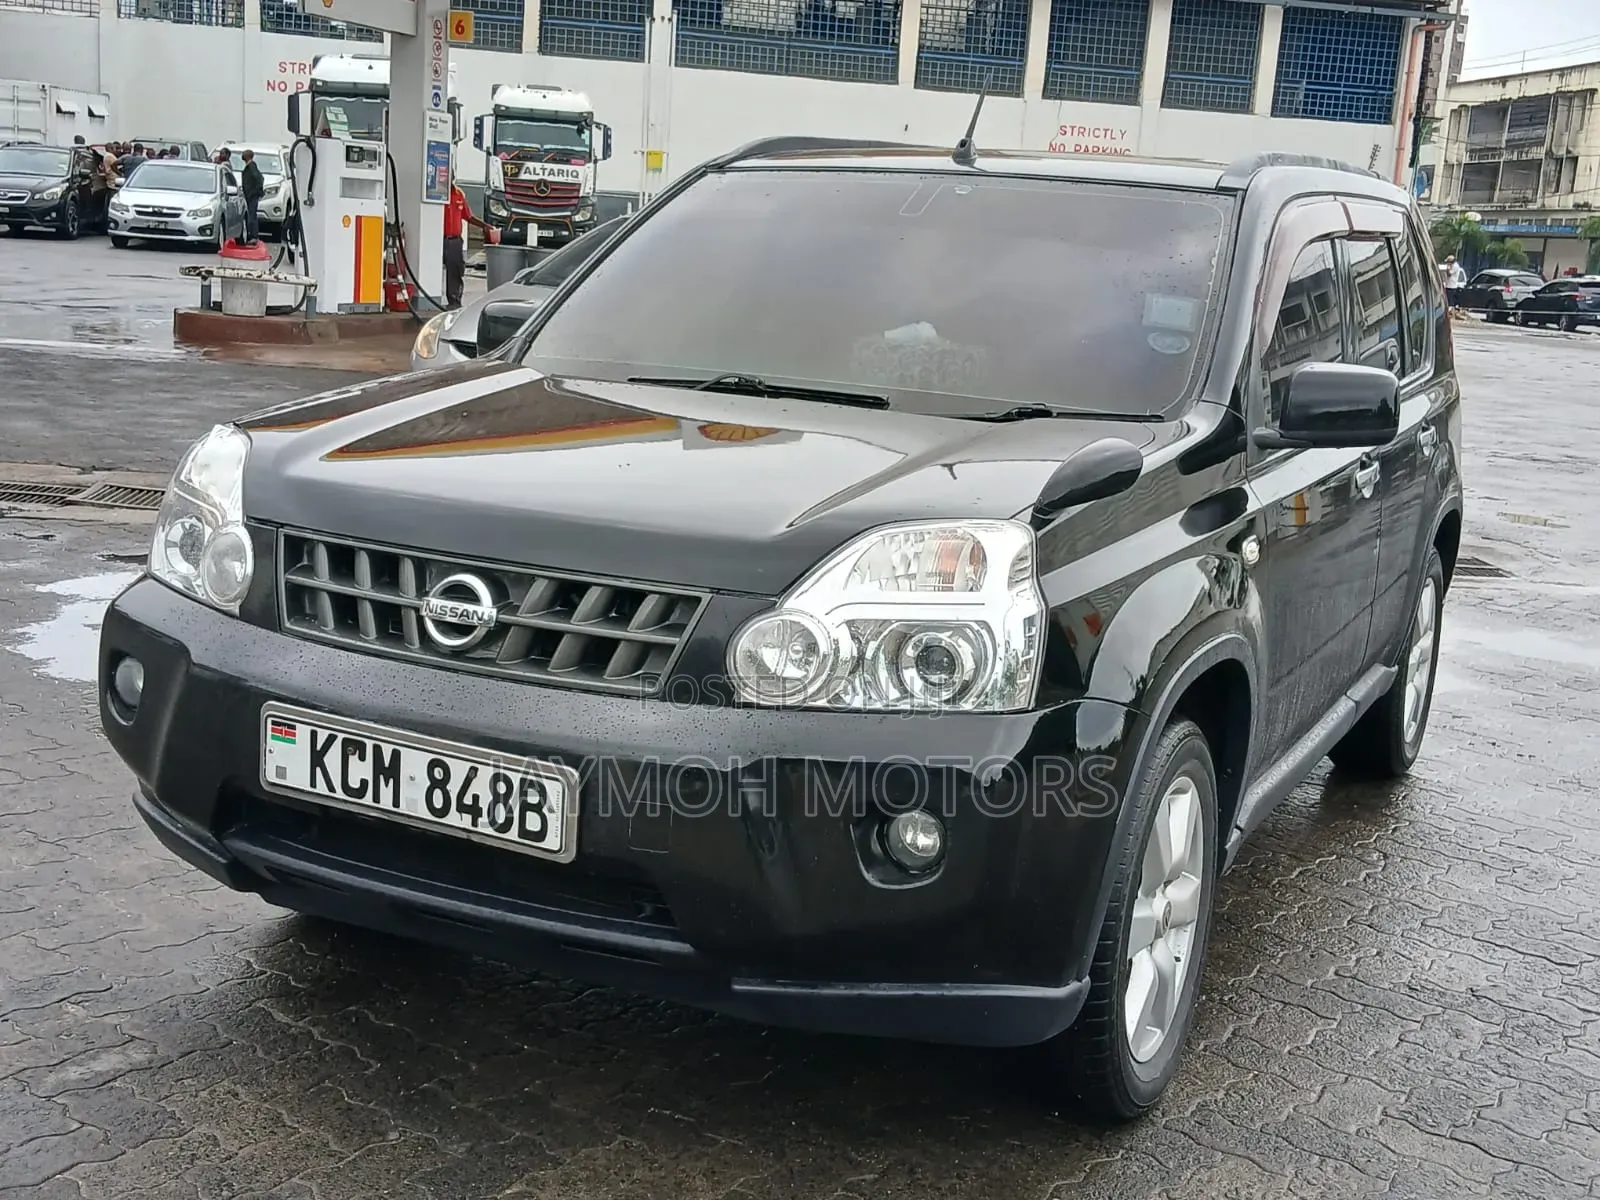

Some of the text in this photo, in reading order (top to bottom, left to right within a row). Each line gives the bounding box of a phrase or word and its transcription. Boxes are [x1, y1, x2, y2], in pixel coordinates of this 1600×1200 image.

[454, 19, 466, 35] 6
[278, 61, 312, 75] STRI
[266, 80, 288, 92] NO
[1059, 125, 1127, 140] STRICTLY
[1048, 142, 1066, 152] NO
[523, 165, 580, 179] ALTARIQ
[424, 601, 485, 622] NISSAN
[308, 729, 402, 808] KCM
[424, 757, 550, 843] 848B
